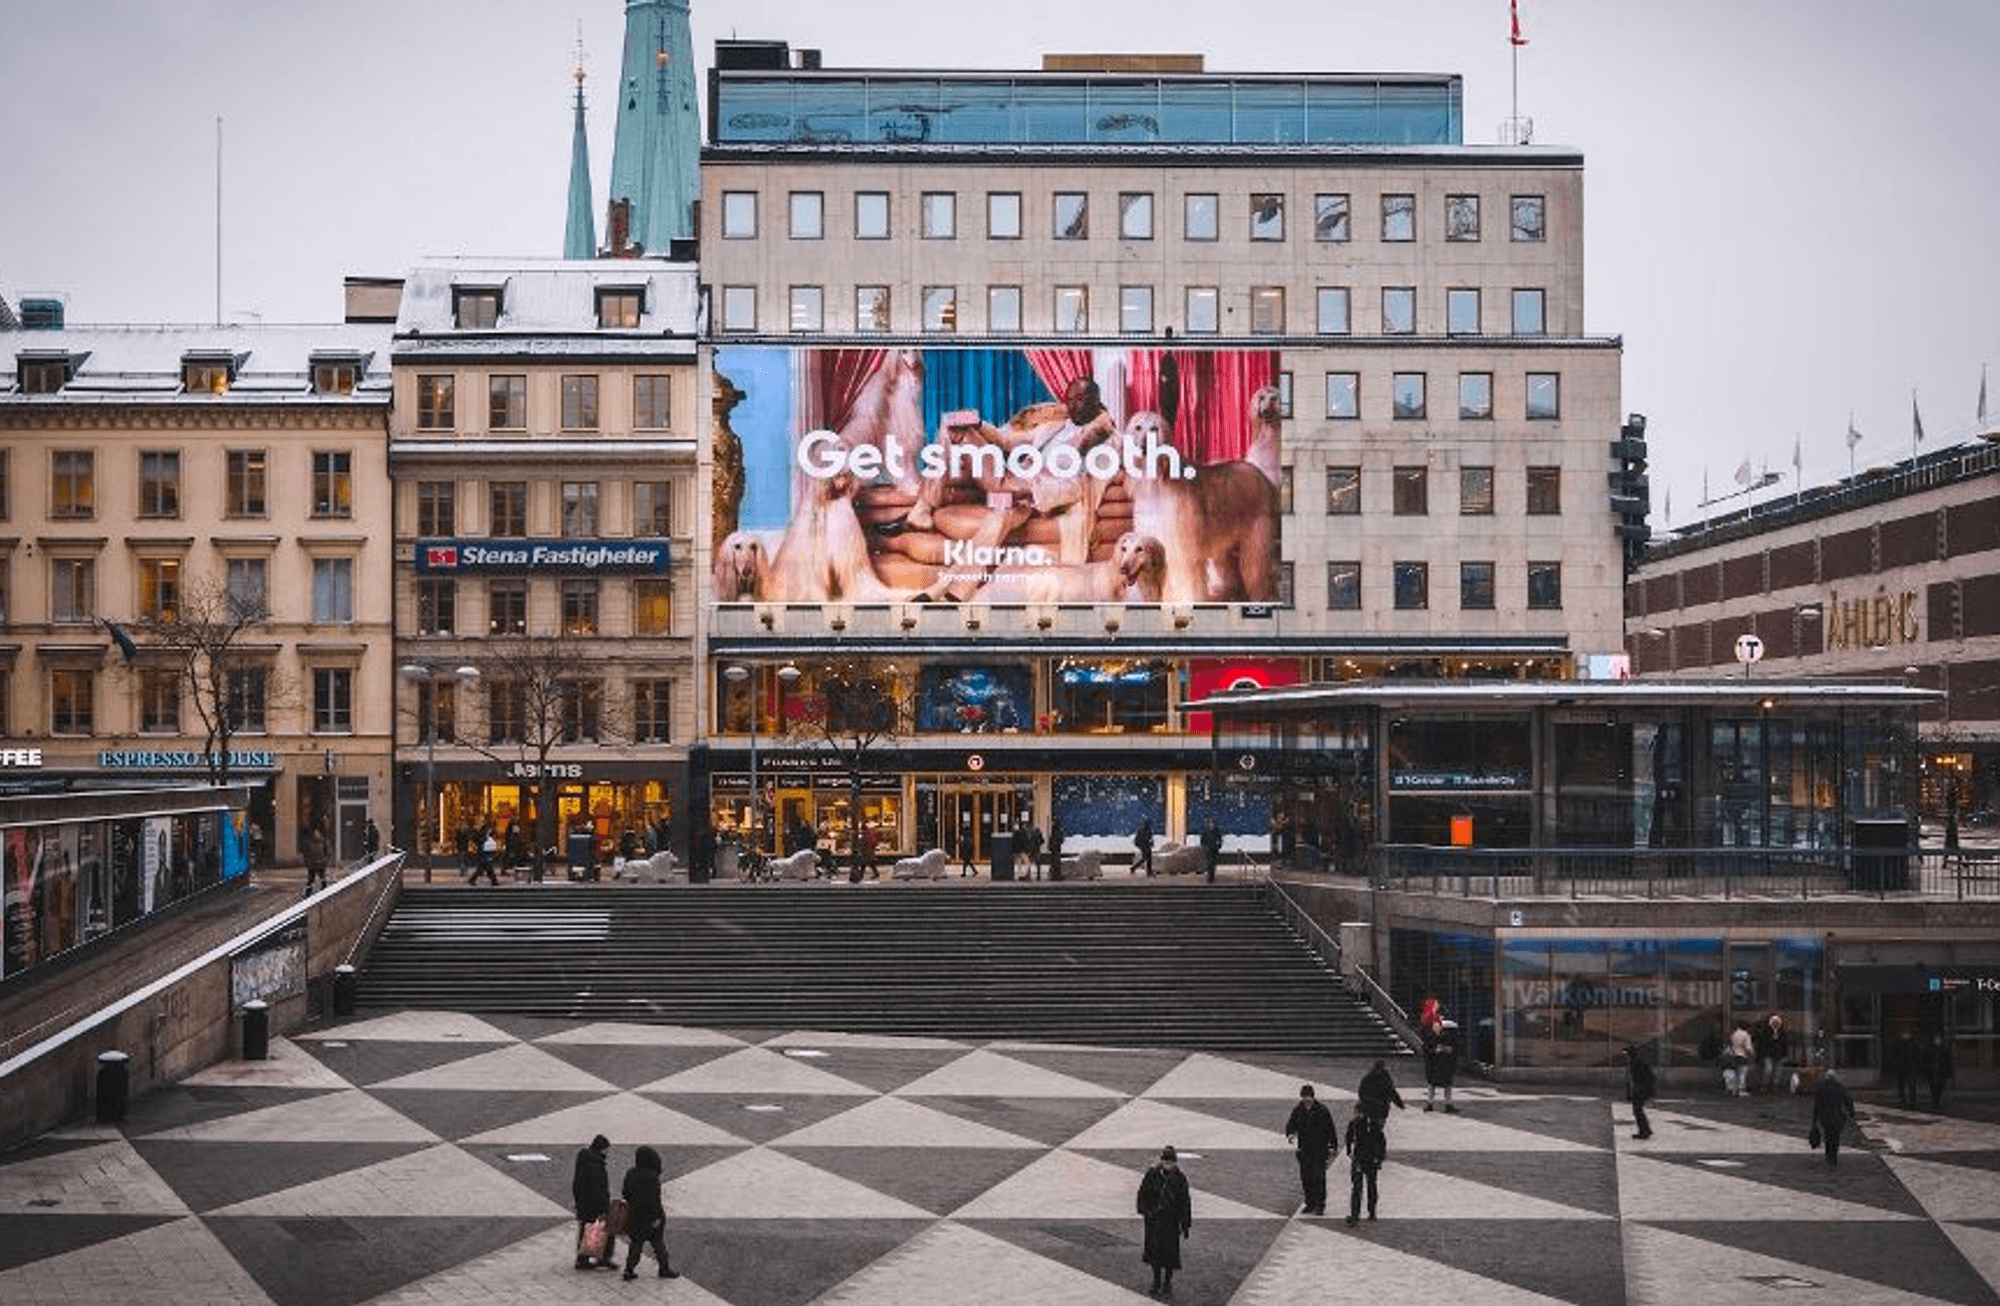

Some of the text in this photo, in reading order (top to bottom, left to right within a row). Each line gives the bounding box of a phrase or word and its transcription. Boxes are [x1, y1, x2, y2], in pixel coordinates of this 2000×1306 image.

[798, 429, 1197, 480] Get smoooth.
[462, 545, 659, 568] Stena Fastigheter
[943, 539, 1052, 566] Klarna.
[0, 749, 42, 766] FEE
[101, 751, 198, 766] ESPRESSO
